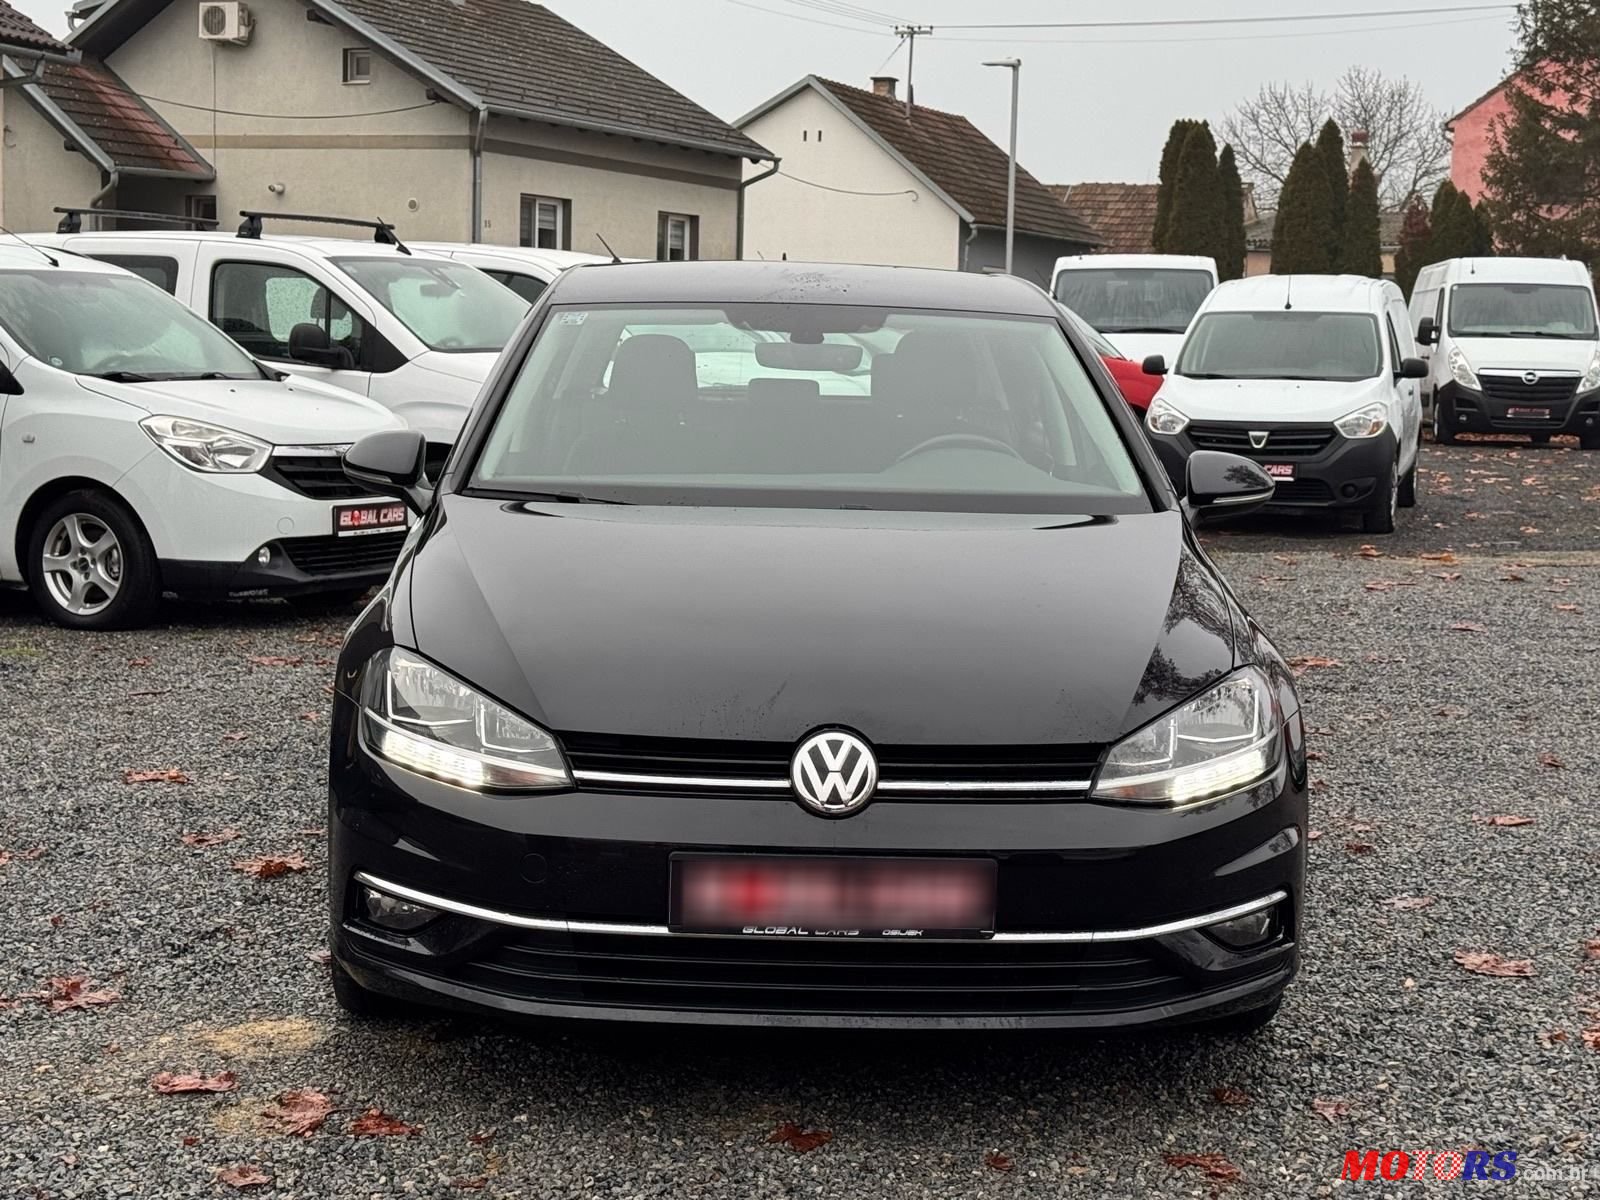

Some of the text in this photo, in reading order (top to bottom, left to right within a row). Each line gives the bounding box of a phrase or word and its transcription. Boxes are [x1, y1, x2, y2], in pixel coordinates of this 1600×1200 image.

[339, 507, 405, 526] GLOBAL CARS
[742, 926, 809, 935] GLOBAL
